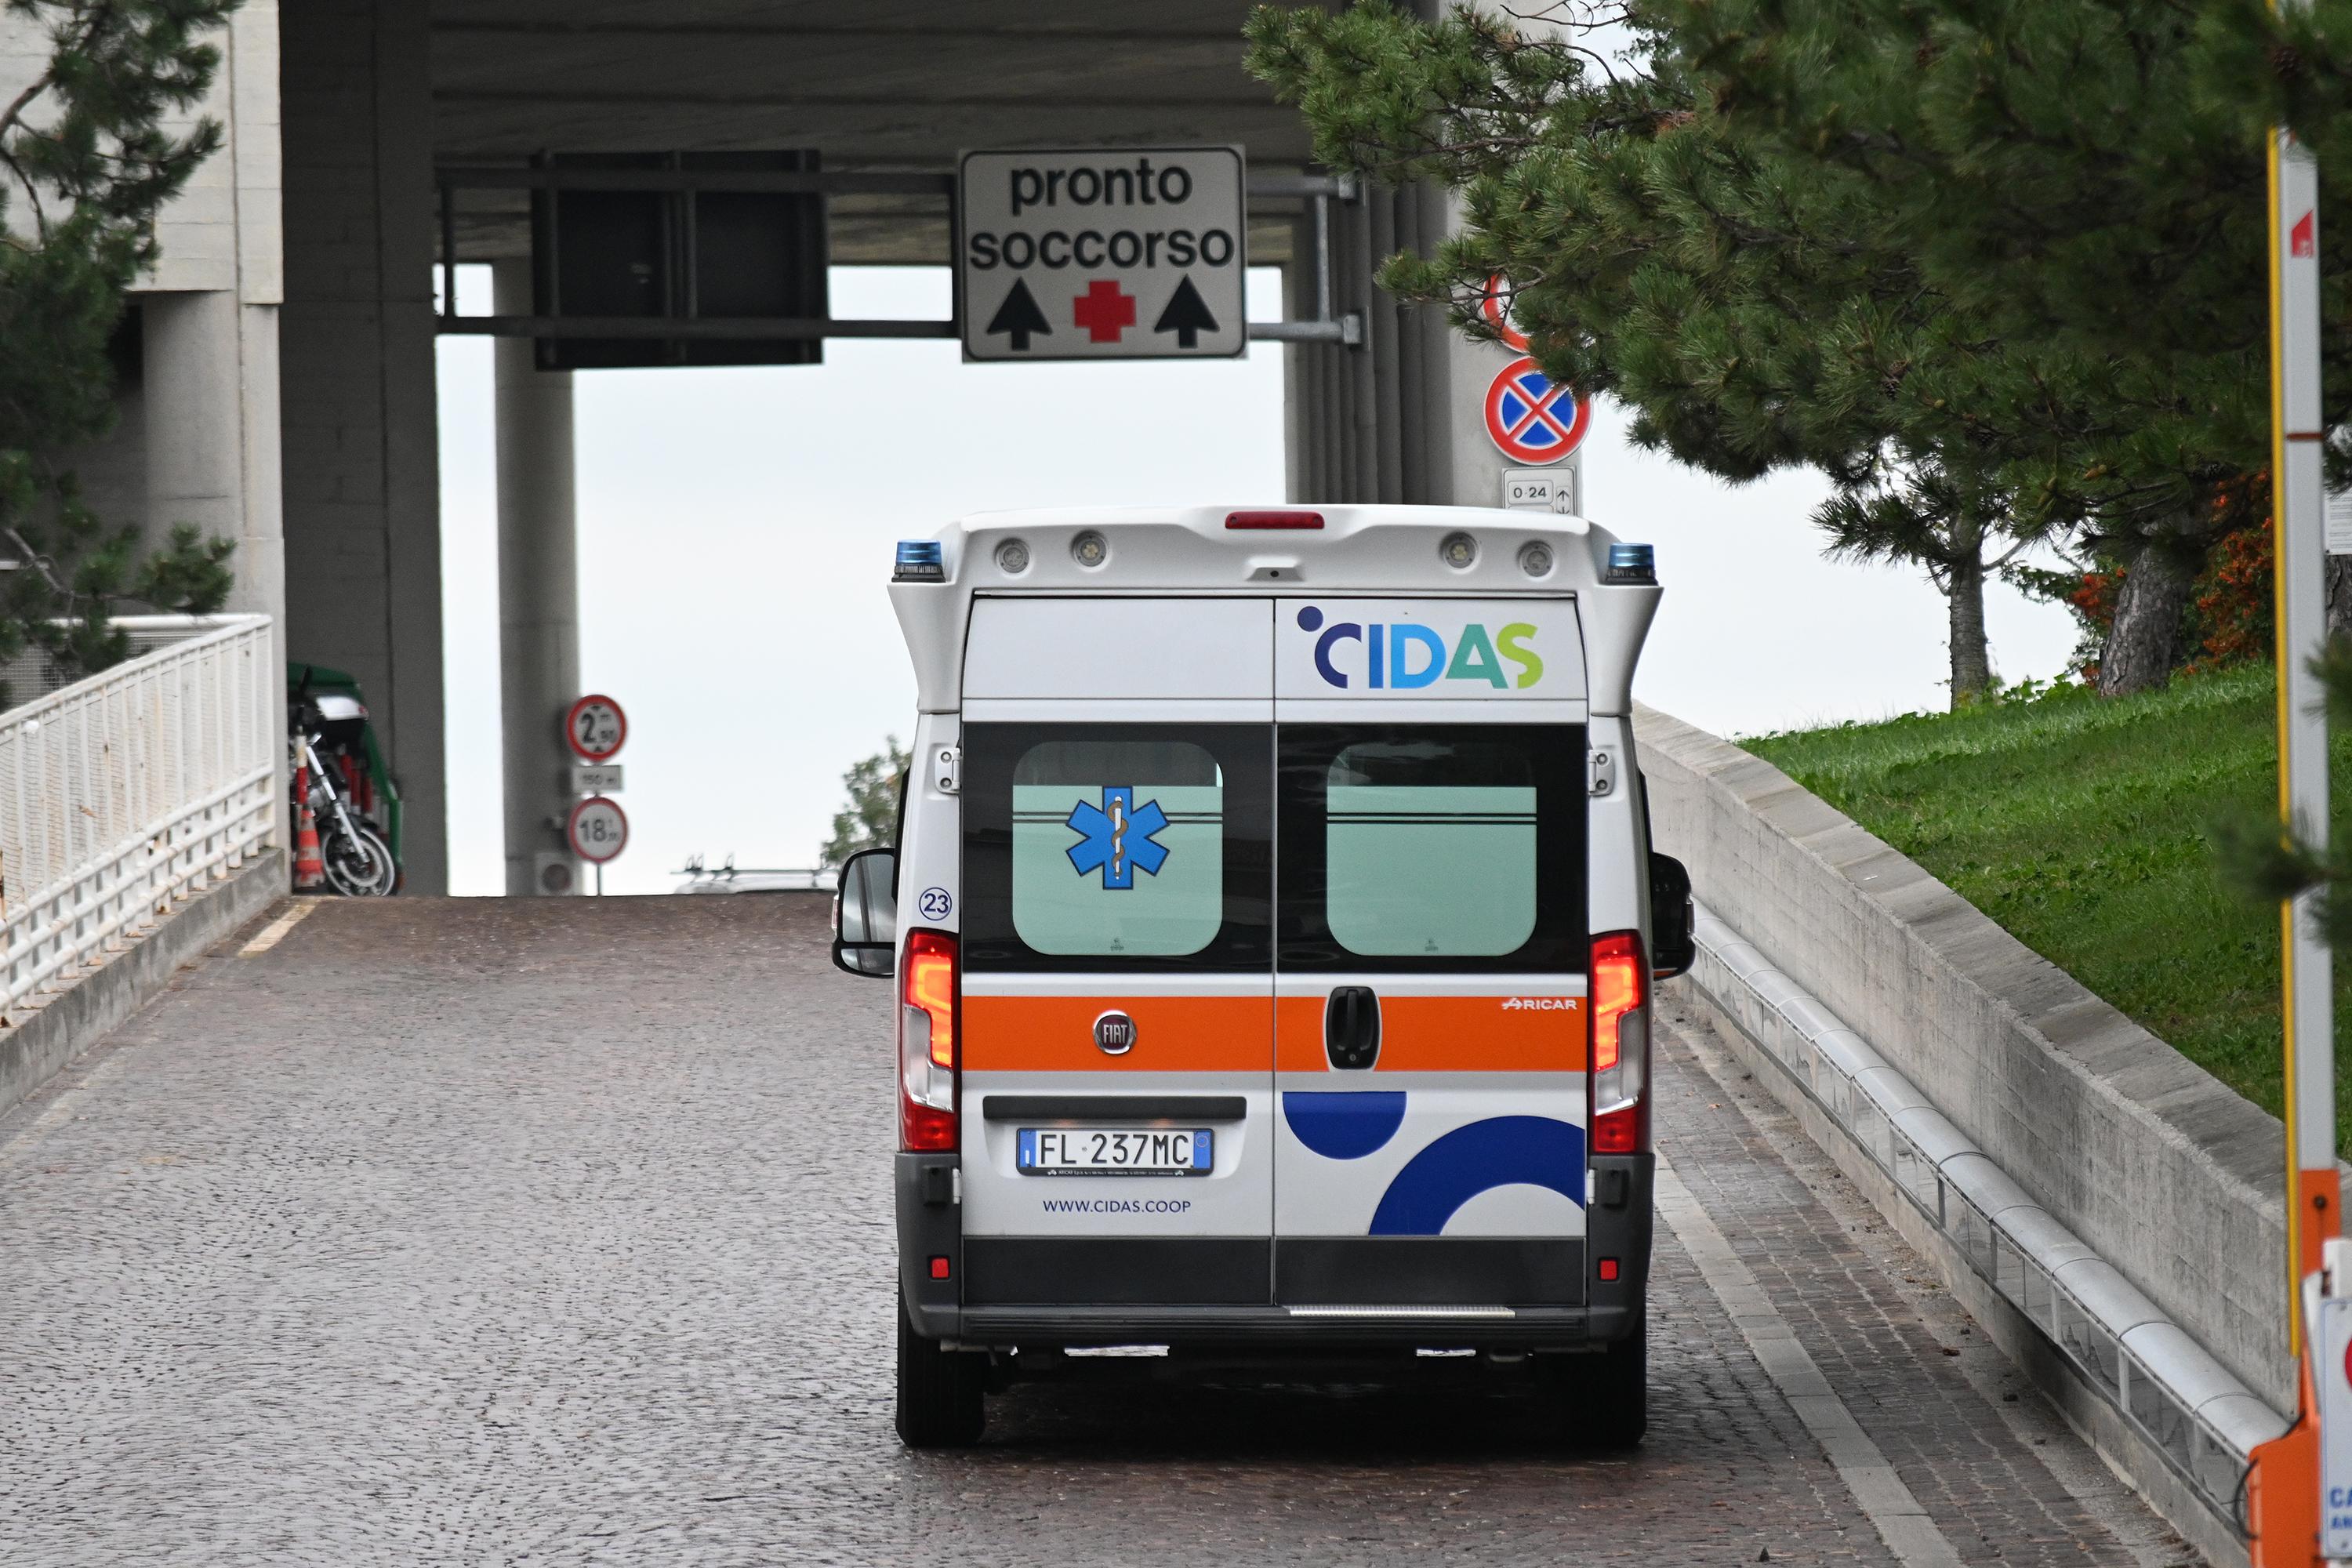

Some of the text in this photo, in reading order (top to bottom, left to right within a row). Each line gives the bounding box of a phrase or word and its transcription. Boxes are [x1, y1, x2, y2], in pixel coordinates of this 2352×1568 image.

[1011, 158, 1193, 216] pronto
[970, 229, 1235, 270] soccorso
[1314, 622, 1544, 689] CIDAS
[924, 893, 949, 913] 23
[1501, 997, 1577, 1010] ARICAR
[1103, 1024, 1127, 1044] FIAT
[1043, 1200, 1191, 1213] WWW.CIDAS.COOP
